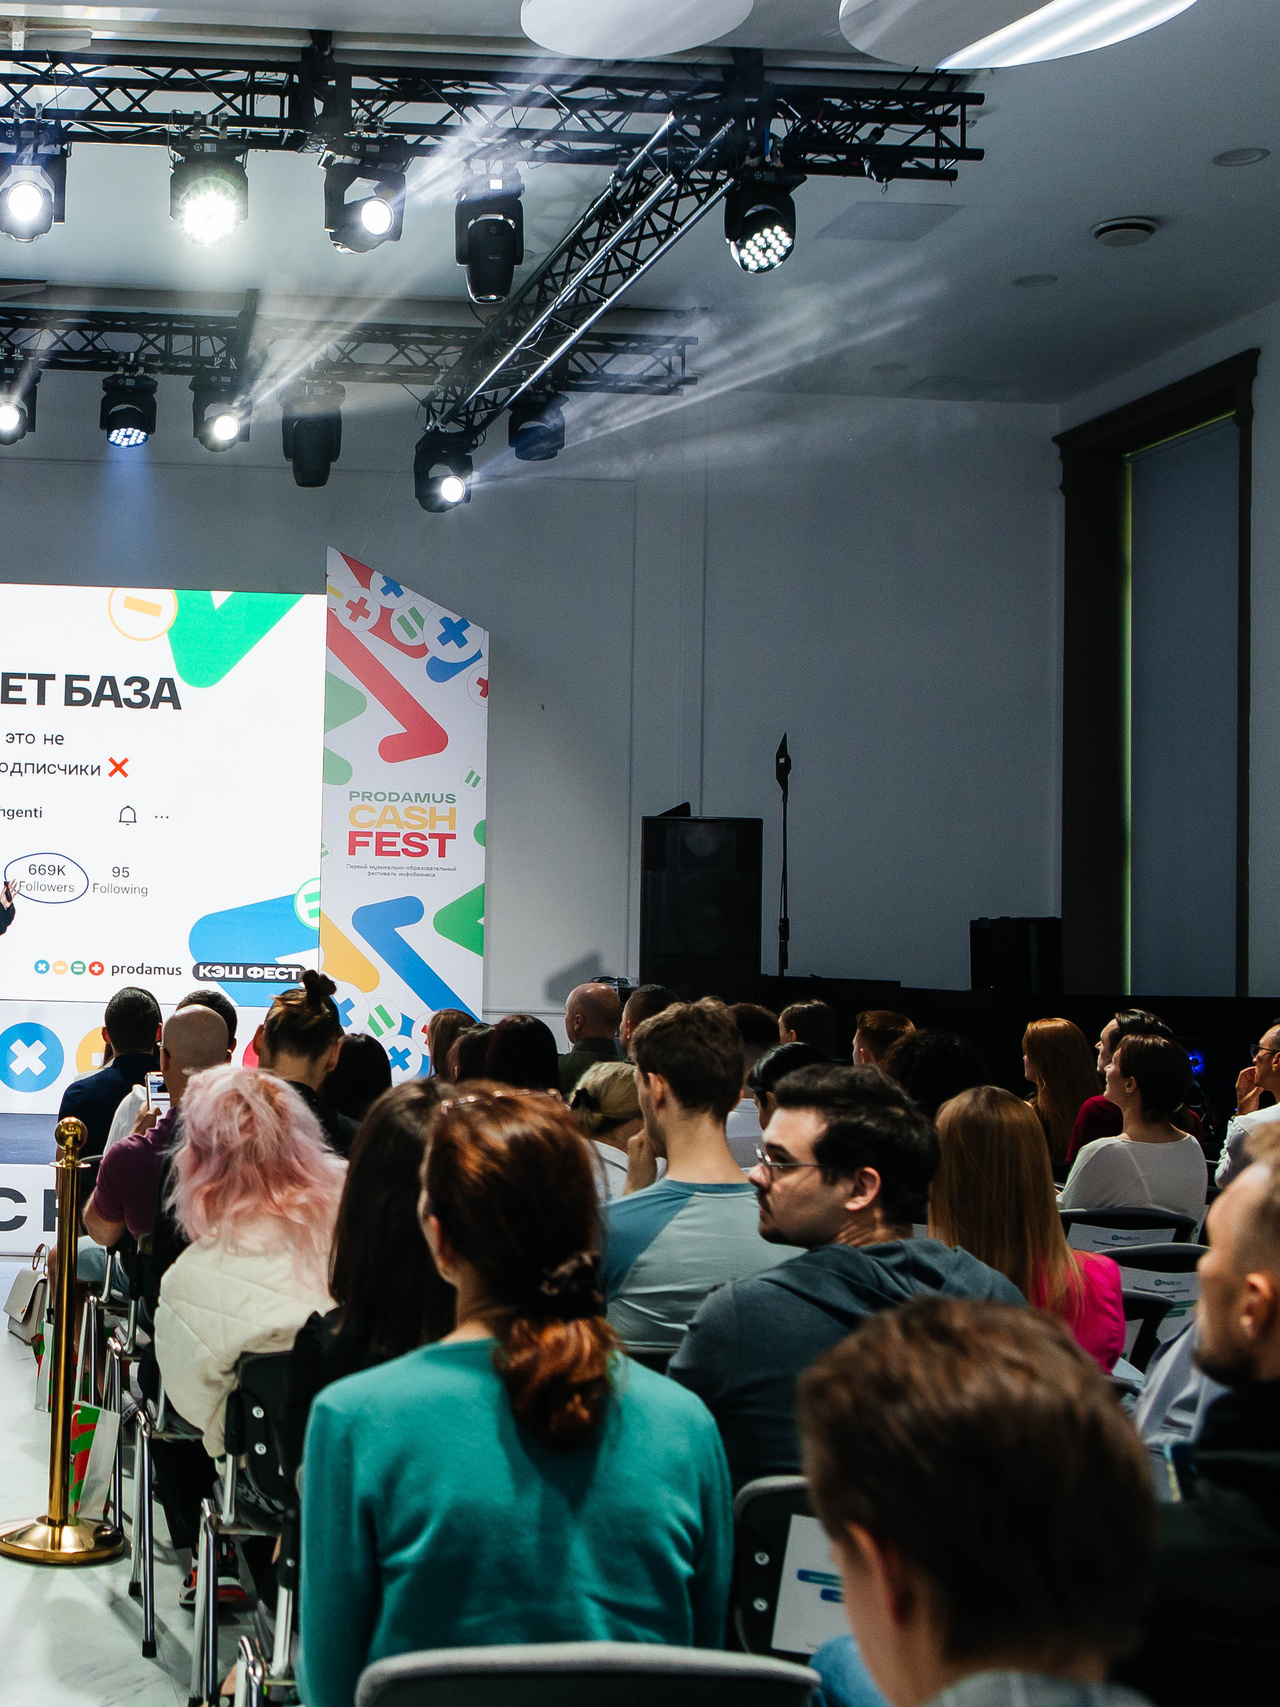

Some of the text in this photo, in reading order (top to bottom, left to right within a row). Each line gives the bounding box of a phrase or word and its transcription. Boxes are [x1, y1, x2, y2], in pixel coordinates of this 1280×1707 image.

[64, 673, 182, 710] БАЗА
[5, 732, 36, 745] это
[43, 732, 65, 746] не
[348, 791, 457, 804] PRODAMUS
[348, 804, 457, 831] CASH
[347, 831, 457, 858] FEST
[28, 864, 66, 876] 669K
[112, 866, 130, 878] 95
[19, 881, 75, 893] Followers
[92, 883, 148, 897] Following
[111, 962, 182, 976] prodamus
[199, 965, 301, 980] КЭШ ФЕСТ
